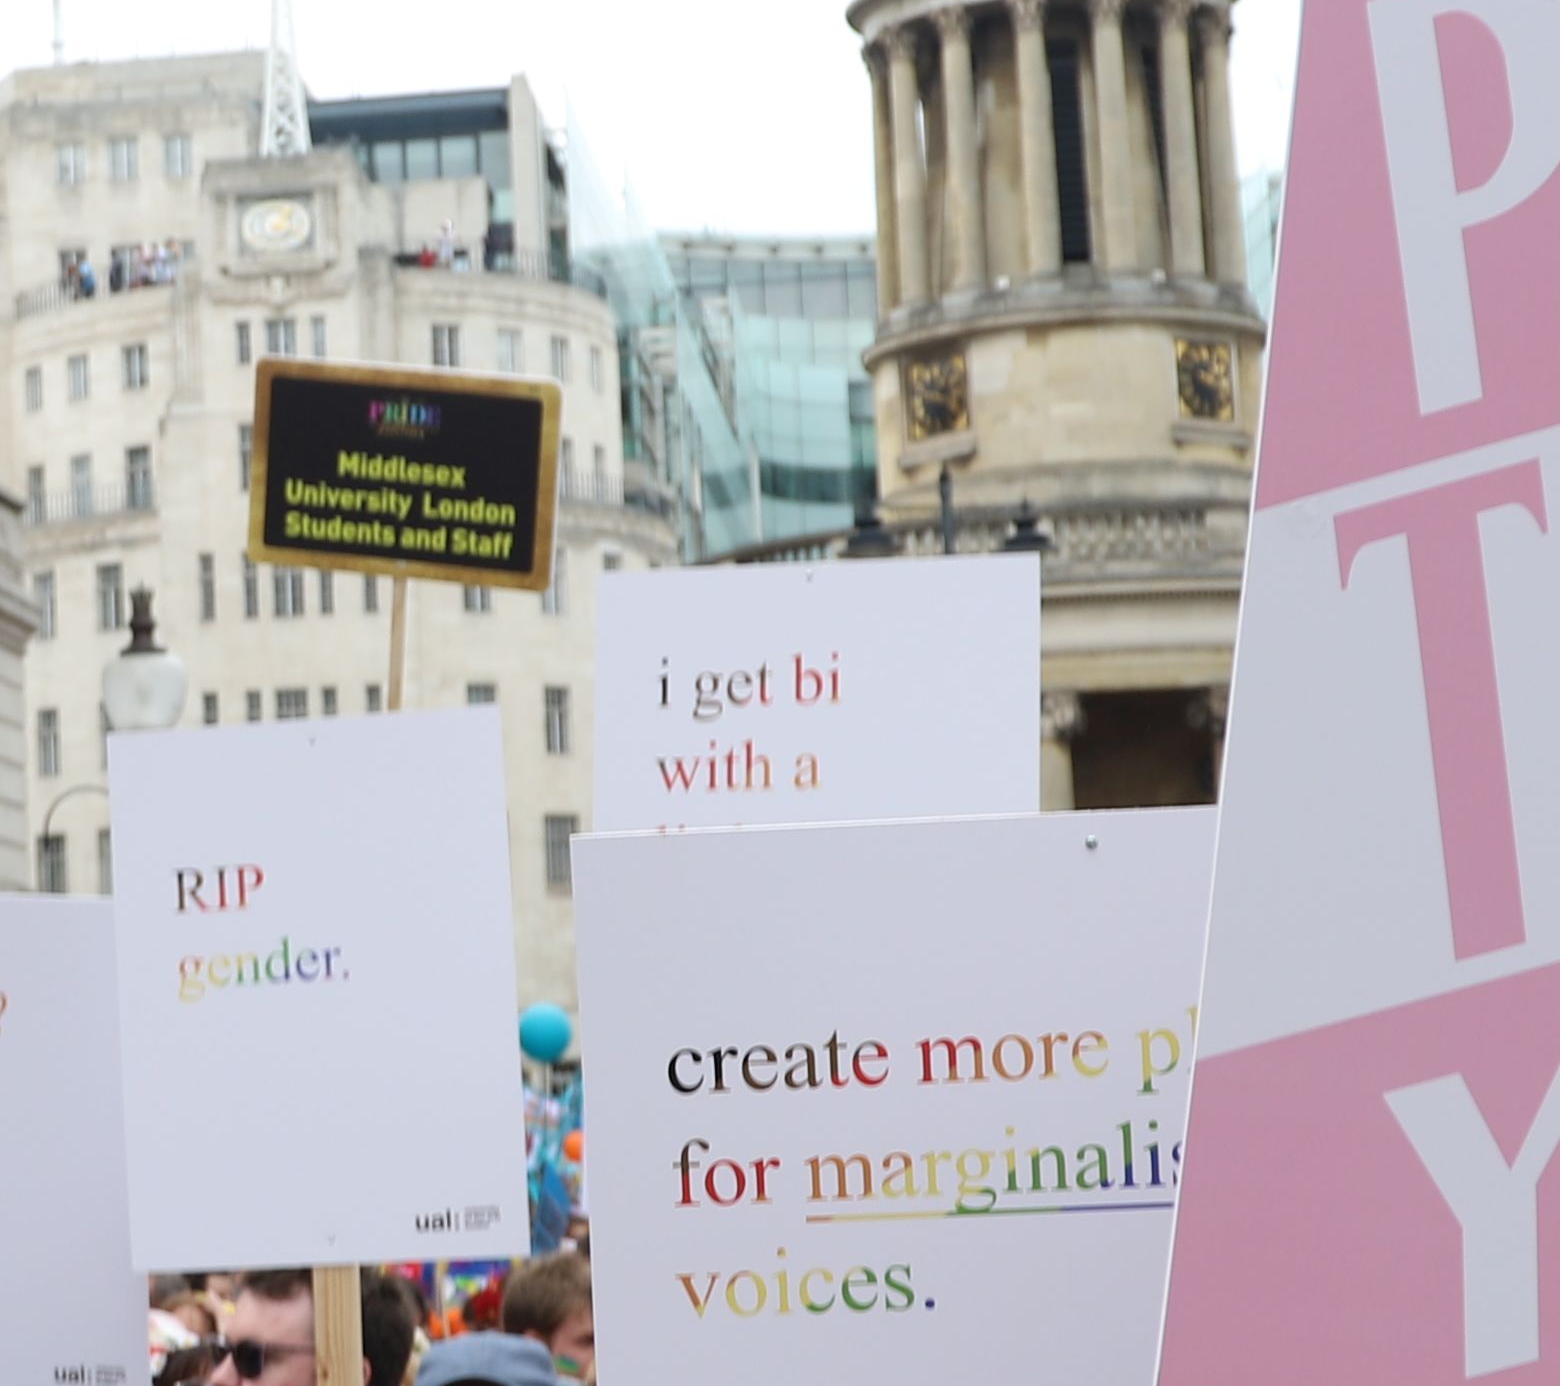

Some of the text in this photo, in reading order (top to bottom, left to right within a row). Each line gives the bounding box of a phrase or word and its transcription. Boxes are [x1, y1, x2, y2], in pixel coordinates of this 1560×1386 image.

[337, 450, 467, 489] Middlesex
[284, 477, 517, 527] University London
[284, 510, 514, 560] Students and Staff
[657, 650, 843, 722] i get bi
[656, 740, 822, 793] with a
[174, 865, 267, 914] RIP
[177, 934, 352, 1005] gender.
[666, 1029, 891, 1095] create
[915, 1028, 1111, 1087] more
[672, 1137, 781, 1209] for
[675, 1245, 937, 1319] voices.
